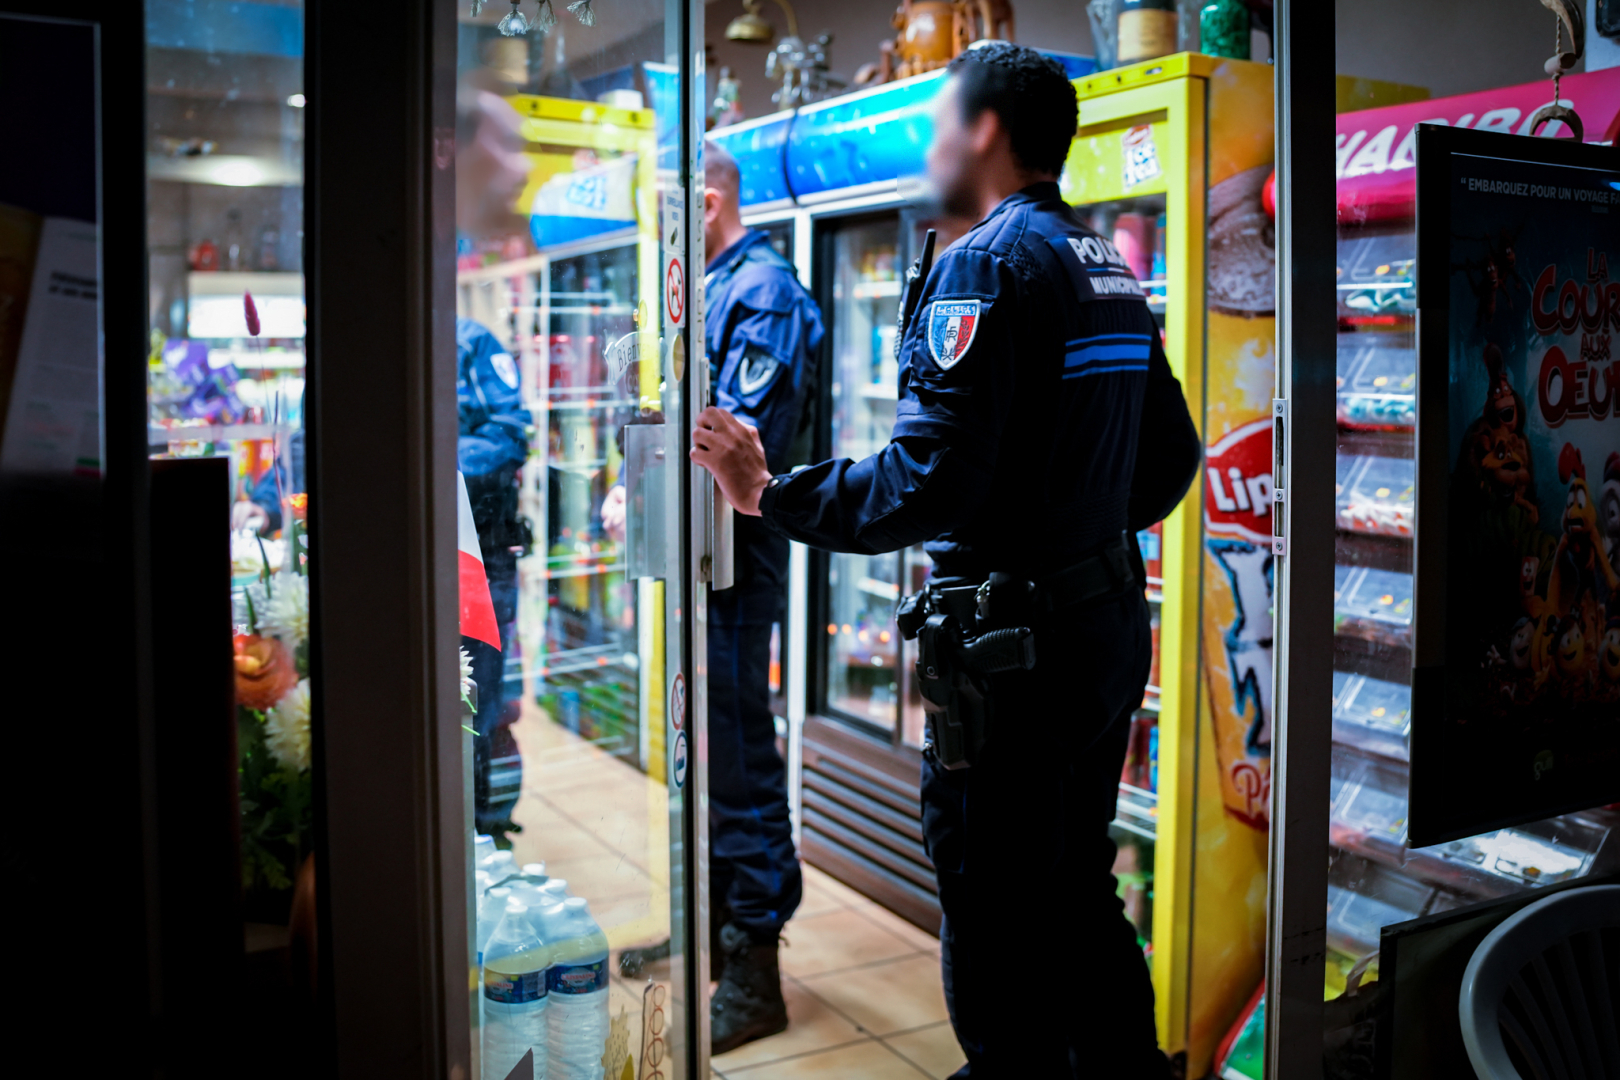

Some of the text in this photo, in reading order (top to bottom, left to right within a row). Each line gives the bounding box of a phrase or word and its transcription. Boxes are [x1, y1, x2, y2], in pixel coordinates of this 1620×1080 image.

[1336, 99, 1575, 177] HAB
[1468, 177, 1529, 197] EMBARQUEZ
[1530, 184, 1556, 199] POUR
[1558, 187, 1572, 201] UN
[1573, 188, 1609, 204] VOYAGE
[1586, 246, 1610, 283] LA
[1580, 333, 1612, 361] AUX
